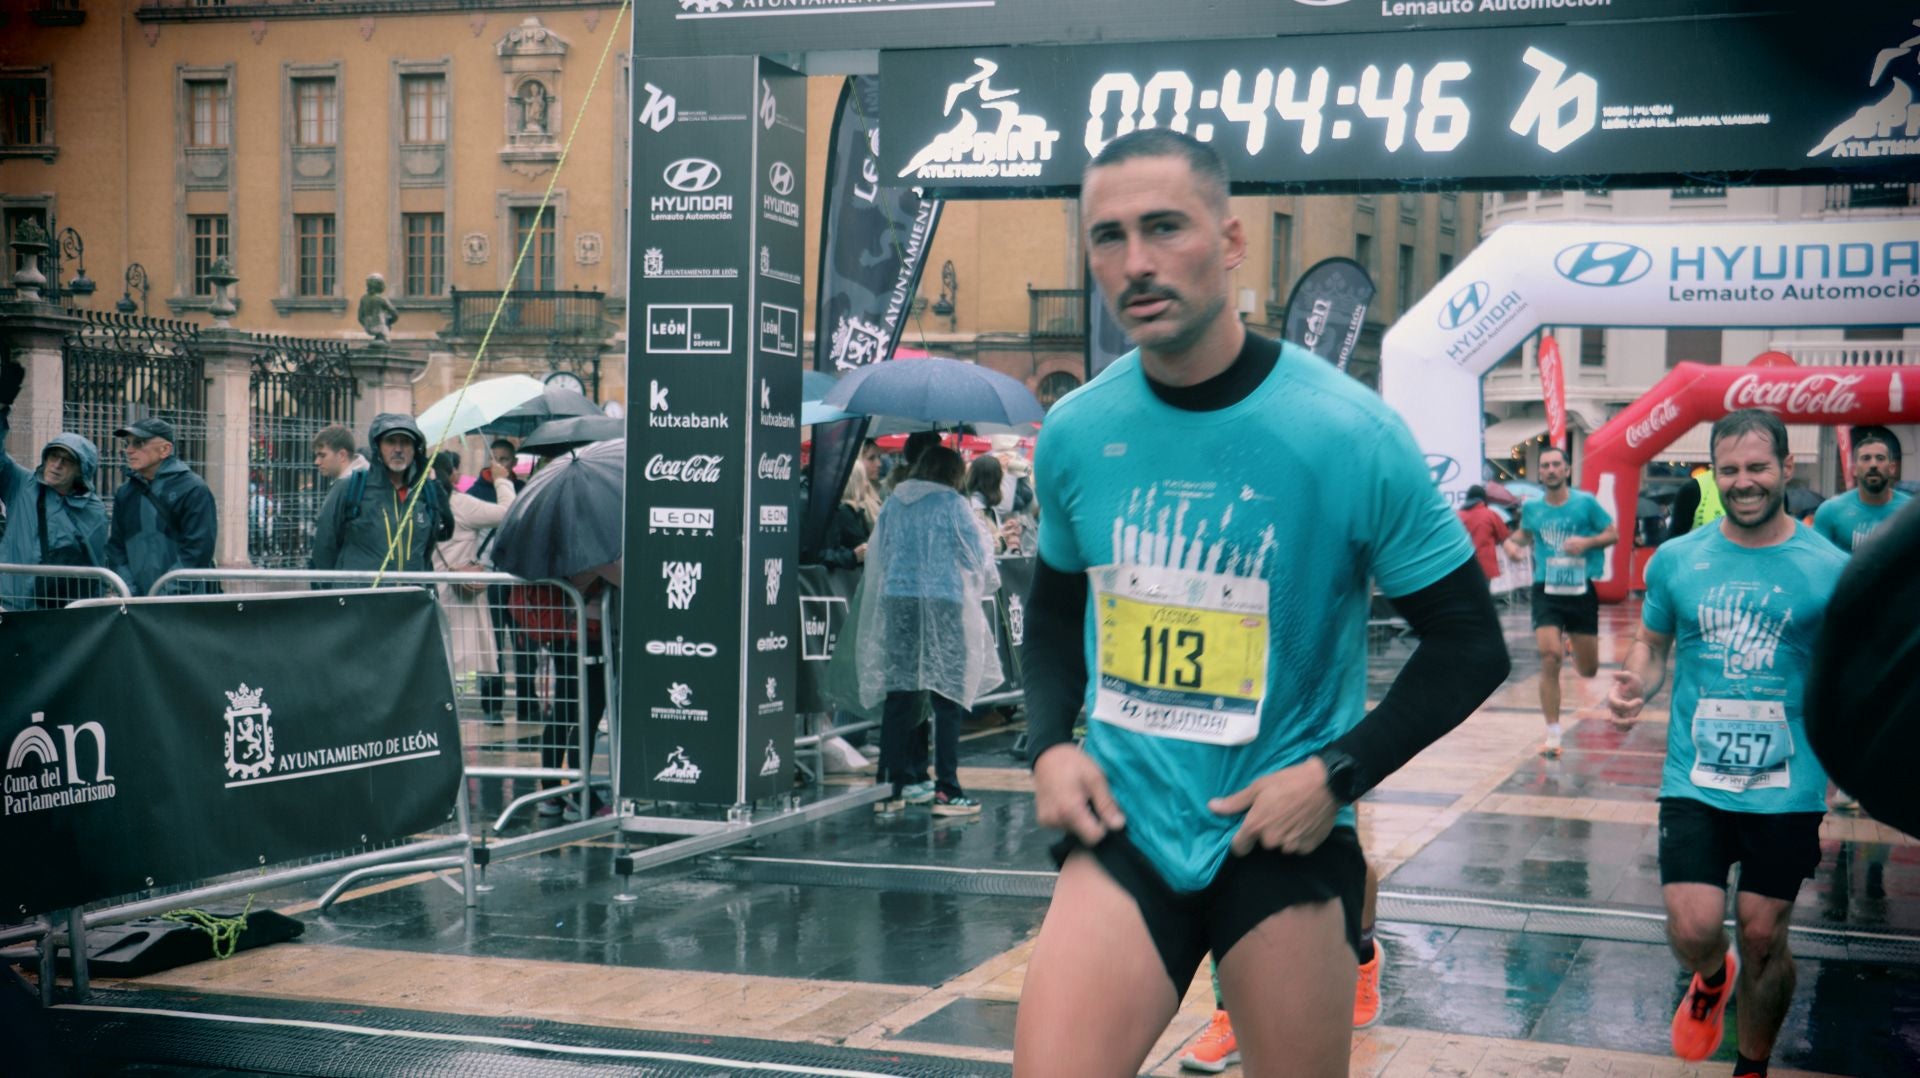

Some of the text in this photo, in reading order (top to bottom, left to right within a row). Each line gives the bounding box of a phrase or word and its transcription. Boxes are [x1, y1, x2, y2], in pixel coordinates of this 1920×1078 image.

[1382, 0, 1473, 16] Lemauto
[1085, 61, 1472, 157] 00:44:46
[651, 195, 732, 212] HYUNDAI
[763, 193, 799, 219] HYUNDAI
[885, 199, 932, 328] AYUNTAMIENT
[1669, 285, 1774, 302] Lemauto
[652, 319, 686, 335] LEÓN
[1446, 290, 1523, 360] HYUNDAI
[1723, 372, 1865, 414] Coca-Cola
[650, 412, 729, 428] kutxabank
[761, 410, 795, 428] kutxabank
[645, 453, 724, 483] Coca-Cola
[653, 511, 712, 524] LEON
[649, 528, 714, 537] PLAZA
[1141, 625, 1204, 689] 113
[279, 729, 439, 772] AYUNTAMIENTO DE LEÓN
[1717, 732, 1771, 766] 257
[4, 767, 61, 794] Cuna del
[4, 782, 116, 816] Parlamentarismo
